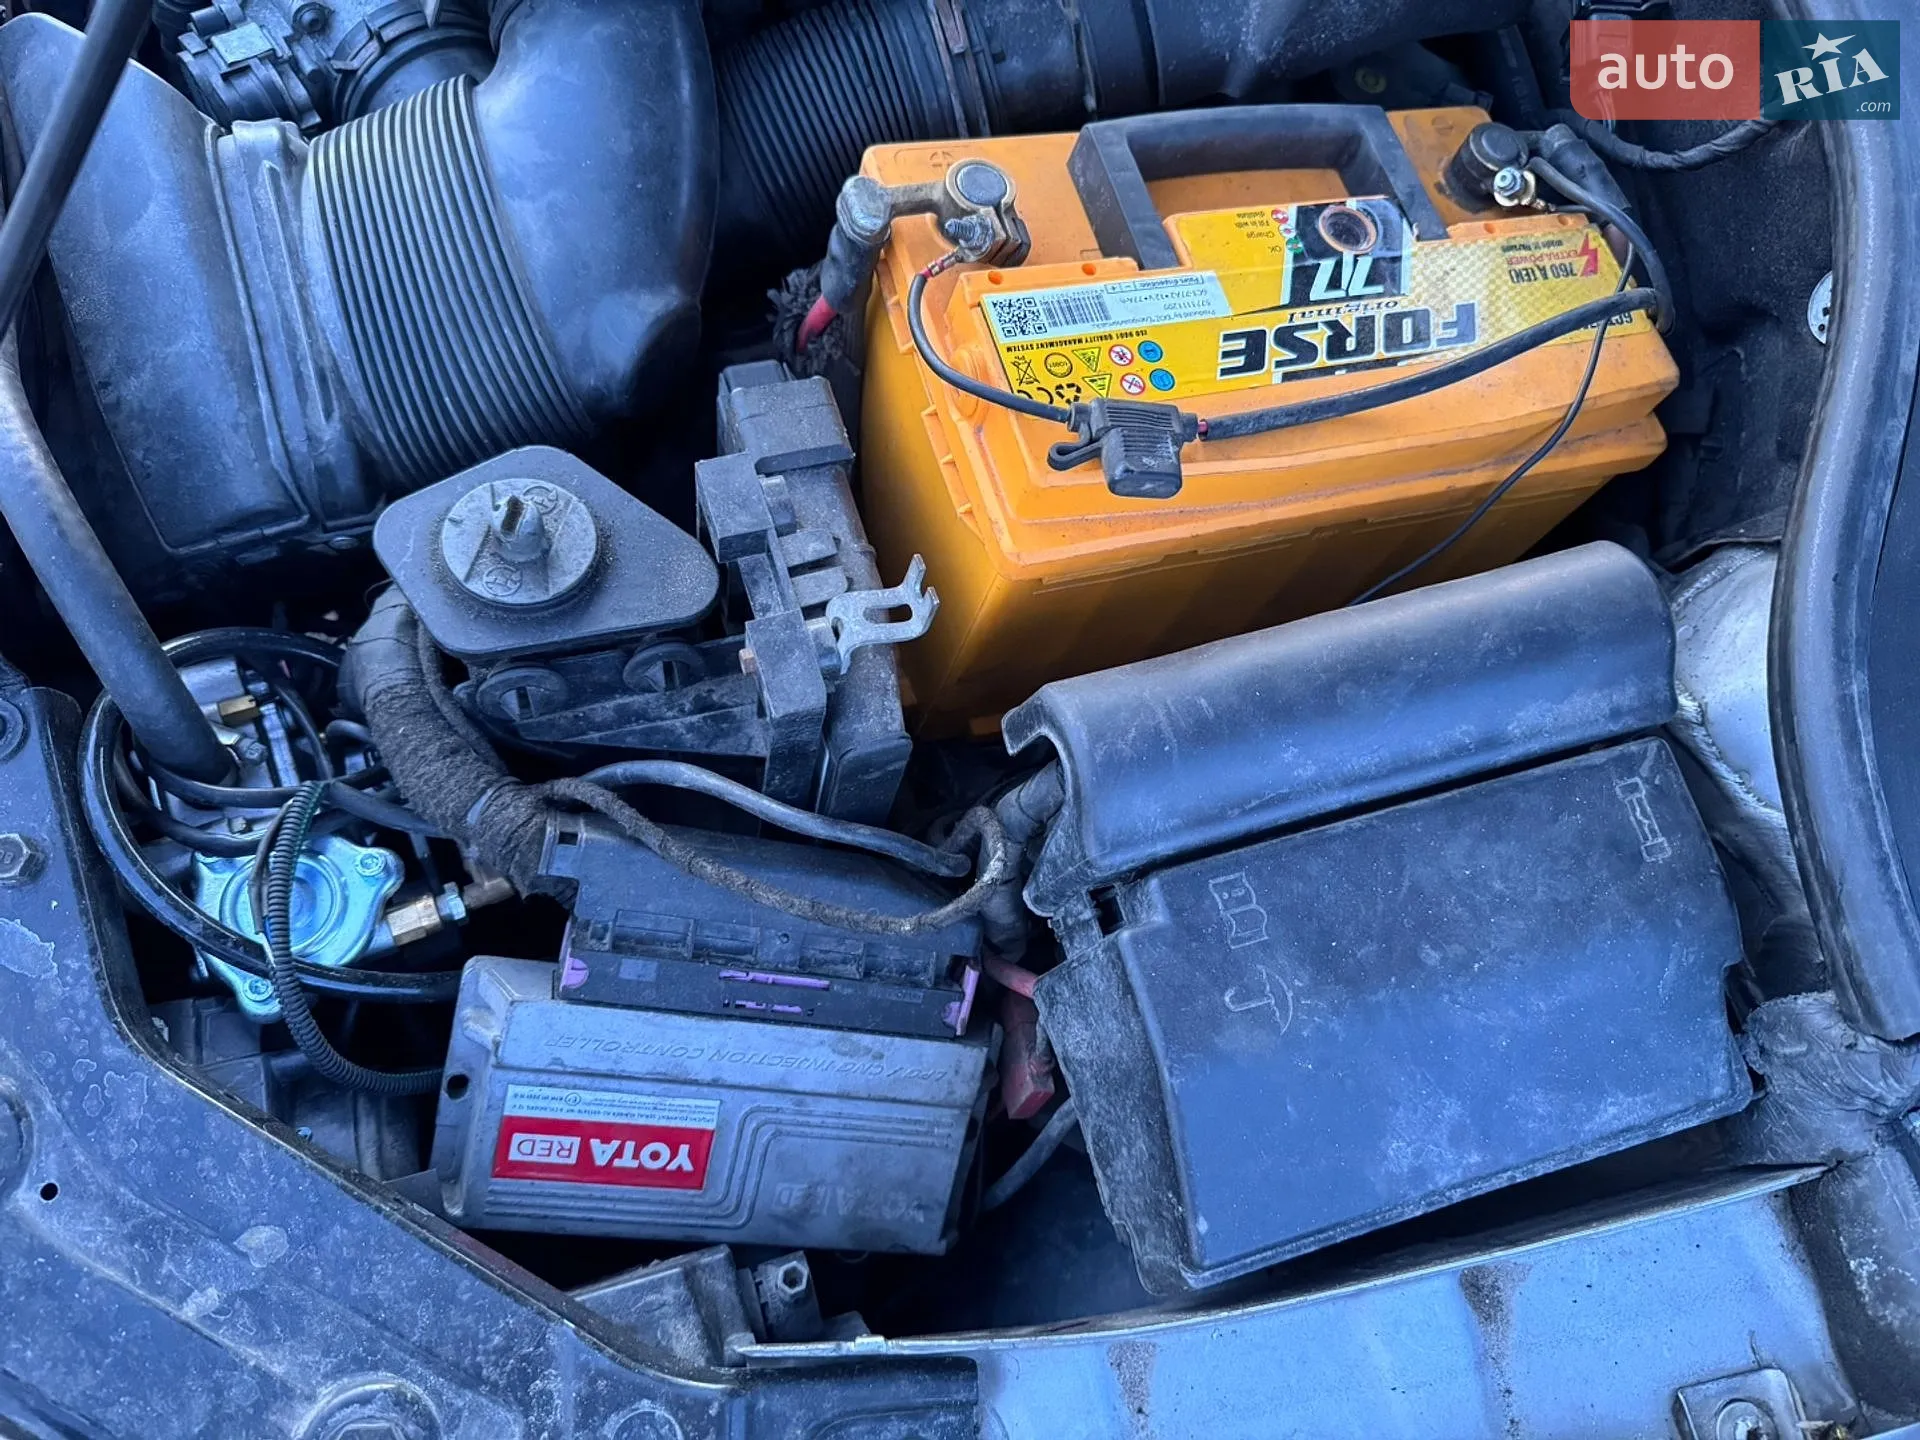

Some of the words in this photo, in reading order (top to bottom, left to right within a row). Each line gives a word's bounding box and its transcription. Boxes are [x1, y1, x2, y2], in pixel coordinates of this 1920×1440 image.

[1246, 230, 1275, 240] Charge
[1268, 246, 1282, 254] OK
[1508, 268, 1537, 284] (EN)
[1534, 264, 1548, 280] A
[1550, 262, 1578, 279] 760
[1287, 300, 1398, 324] original
[1036, 338, 1083, 349] MANAGEMENT
[1084, 334, 1113, 344] QUALITY
[1216, 299, 1479, 380] FORSE
[1006, 344, 1034, 353] SYSTEM
[544, 1035, 704, 1060] CONTROLLER
[708, 1048, 835, 1072] INJECTION
[517, 1138, 574, 1158] RED
[590, 1138, 694, 1172] YOTA
